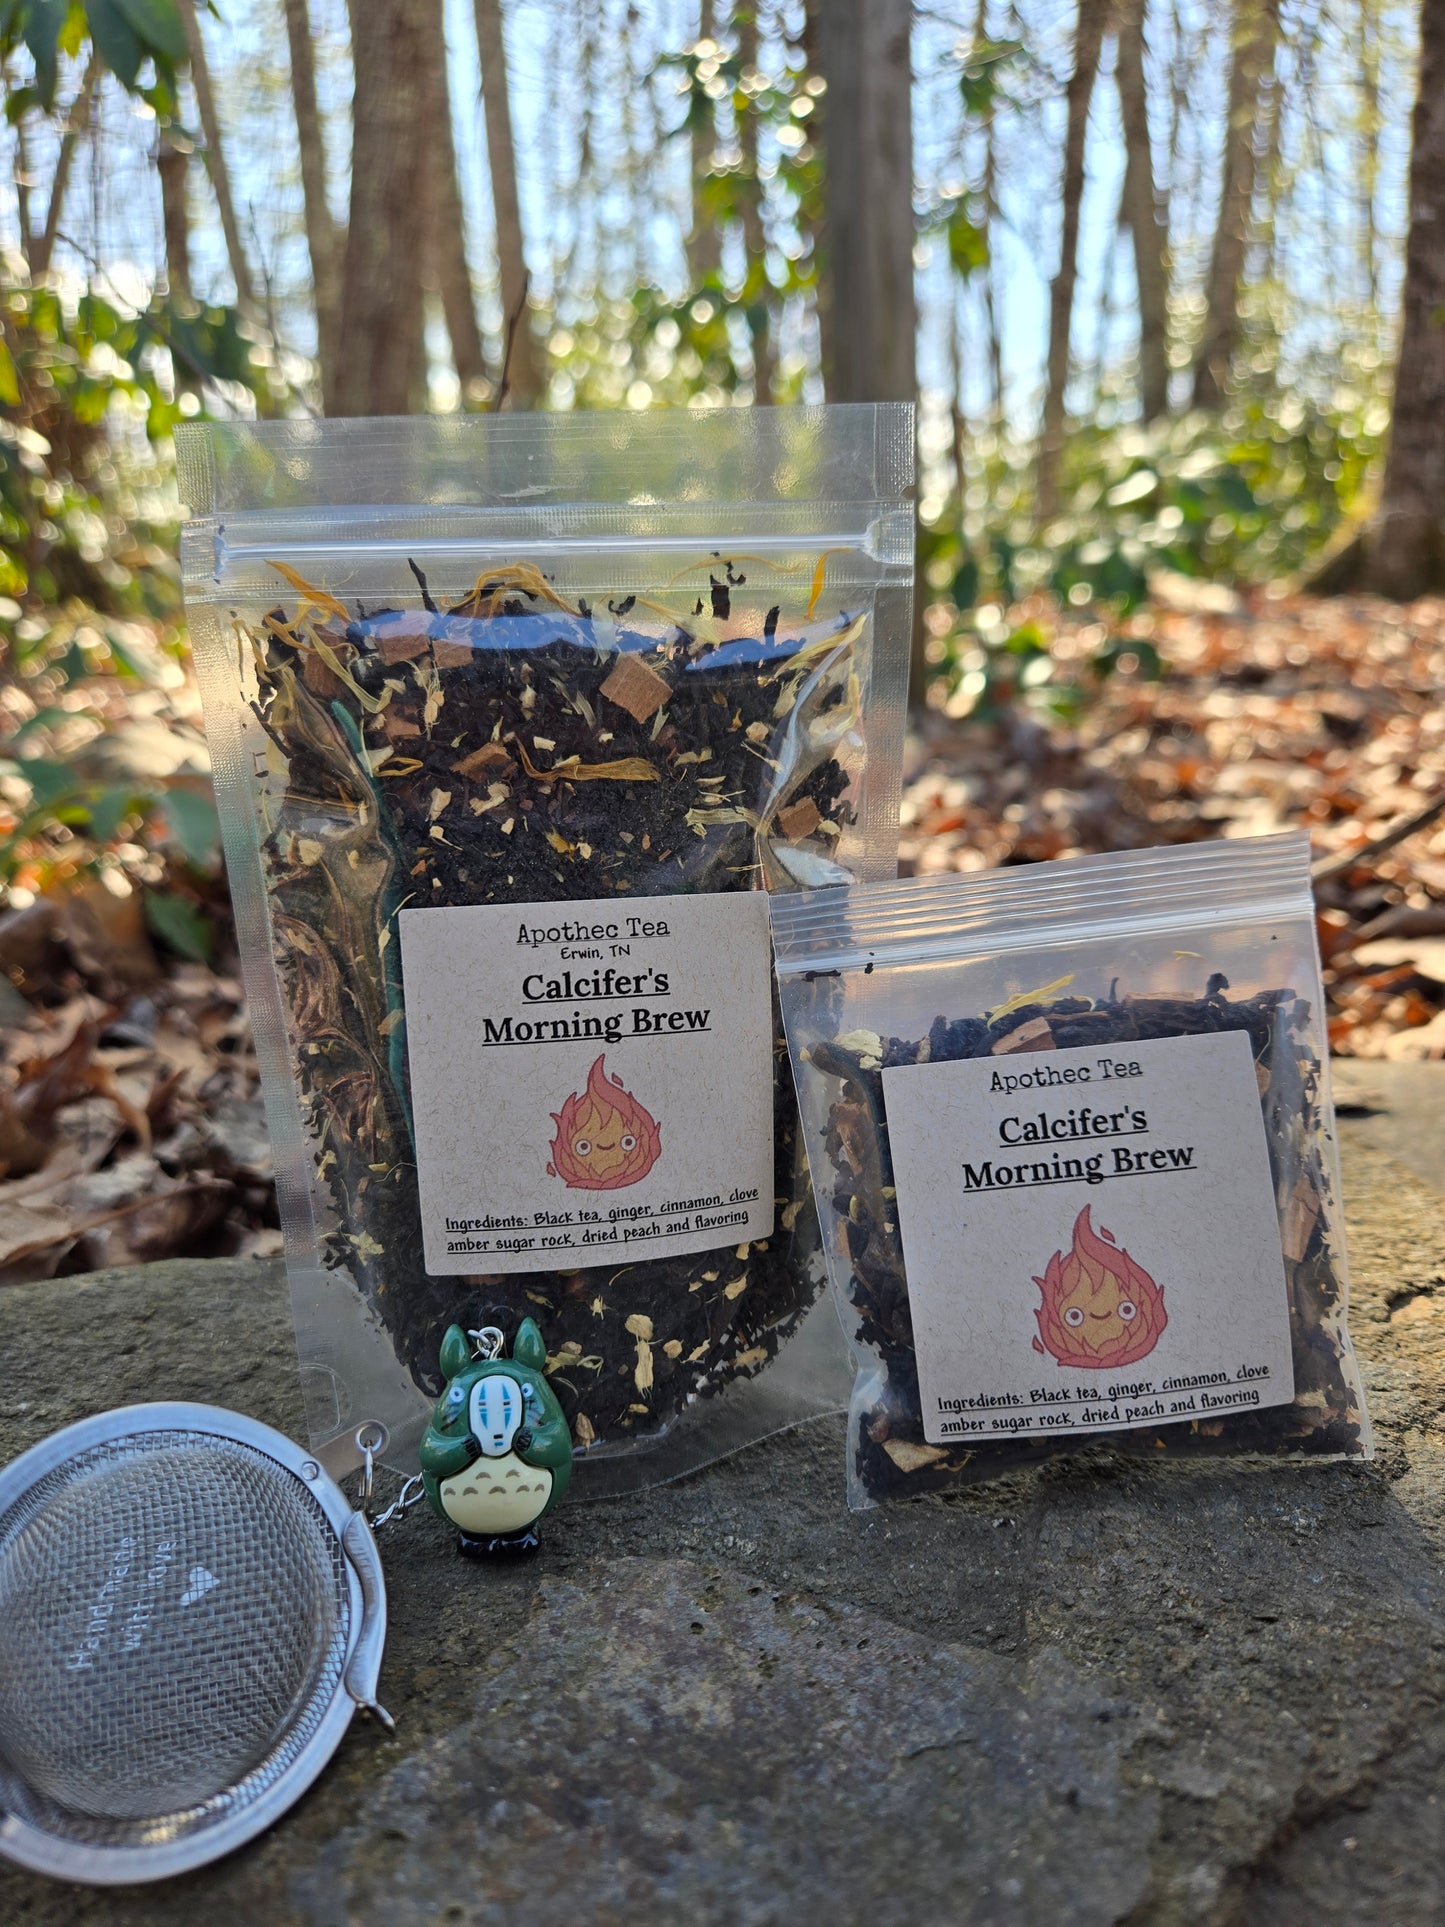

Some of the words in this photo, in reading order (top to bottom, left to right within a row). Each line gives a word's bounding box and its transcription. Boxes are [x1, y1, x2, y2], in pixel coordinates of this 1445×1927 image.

[517, 921, 619, 948] Apothec
[626, 917, 670, 938] Tea
[561, 946, 603, 960] Erwin,
[609, 944, 631, 957] TN
[522, 967, 670, 1003] Calcifer's
[483, 1011, 624, 1045] Morning
[631, 1008, 711, 1034] Brew
[990, 1066, 1091, 1094] Apothec
[1097, 1059, 1143, 1079] Tea
[999, 1105, 1148, 1146] Calcifer's
[962, 1152, 1104, 1192] Morning
[1111, 1146, 1196, 1176] Brew
[445, 1215, 528, 1235] Ingredients:
[533, 1210, 573, 1226] Black
[578, 1211, 602, 1223] tea,
[608, 1206, 654, 1222] ginger,
[660, 1194, 724, 1213] cinnamon,
[729, 1187, 759, 1203] clove
[447, 1237, 490, 1253] amber
[496, 1236, 535, 1253] sugar
[541, 1232, 576, 1247] rock,
[582, 1228, 618, 1243] dried
[624, 1224, 661, 1243] peach
[666, 1218, 690, 1233] and
[694, 1210, 749, 1229] flavoring
[937, 1393, 1024, 1415] Ingredients:
[1029, 1386, 1071, 1404] Black
[1076, 1386, 1102, 1401] tea,
[1108, 1381, 1157, 1402] ginger,
[1162, 1370, 1231, 1391] cinnamon,
[1236, 1363, 1270, 1380] clove
[940, 1416, 986, 1434] amber
[991, 1416, 1033, 1433] sugar
[1039, 1410, 1075, 1427] rock,
[1081, 1405, 1120, 1423] dried
[1126, 1402, 1165, 1422] peach
[1170, 1396, 1196, 1412] and
[1201, 1388, 1260, 1409] flavoring
[66, 1536, 140, 1669] Handmade
